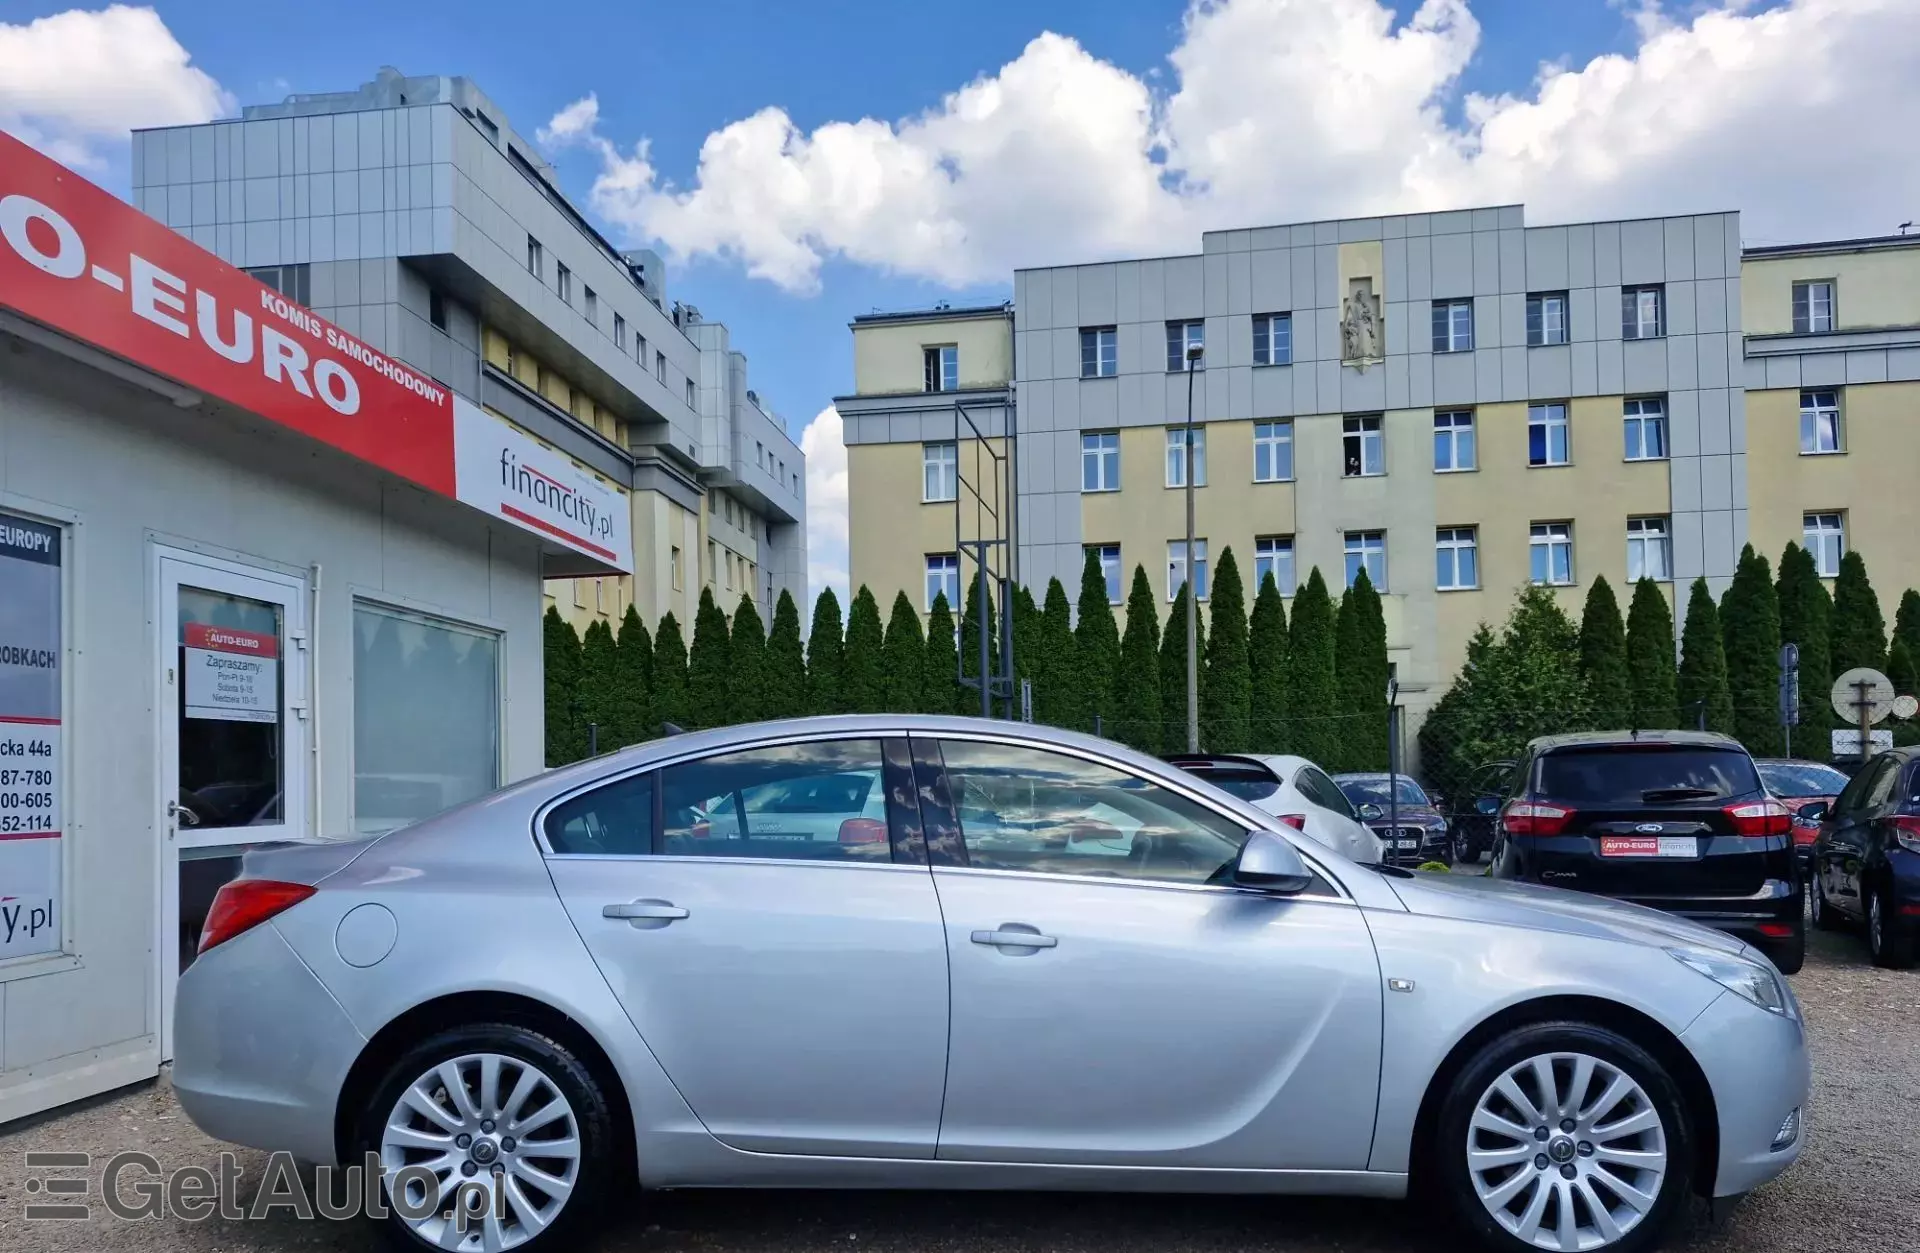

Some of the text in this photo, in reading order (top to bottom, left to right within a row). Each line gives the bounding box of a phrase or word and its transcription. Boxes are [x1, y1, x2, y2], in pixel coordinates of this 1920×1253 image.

[0, 194, 361, 416] O-EURO
[261, 289, 445, 407] KOMIS SAMOCHODOWY
[500, 448, 614, 540] financity.pl
[0, 524, 51, 553] EUROPY
[210, 633, 259, 649] AUTO-EURO
[0, 645, 56, 669] OBKACH
[28, 740, 52, 757] 44a
[0, 814, 52, 832] 52-114
[1605, 842, 1656, 850] AUTO-EURO
